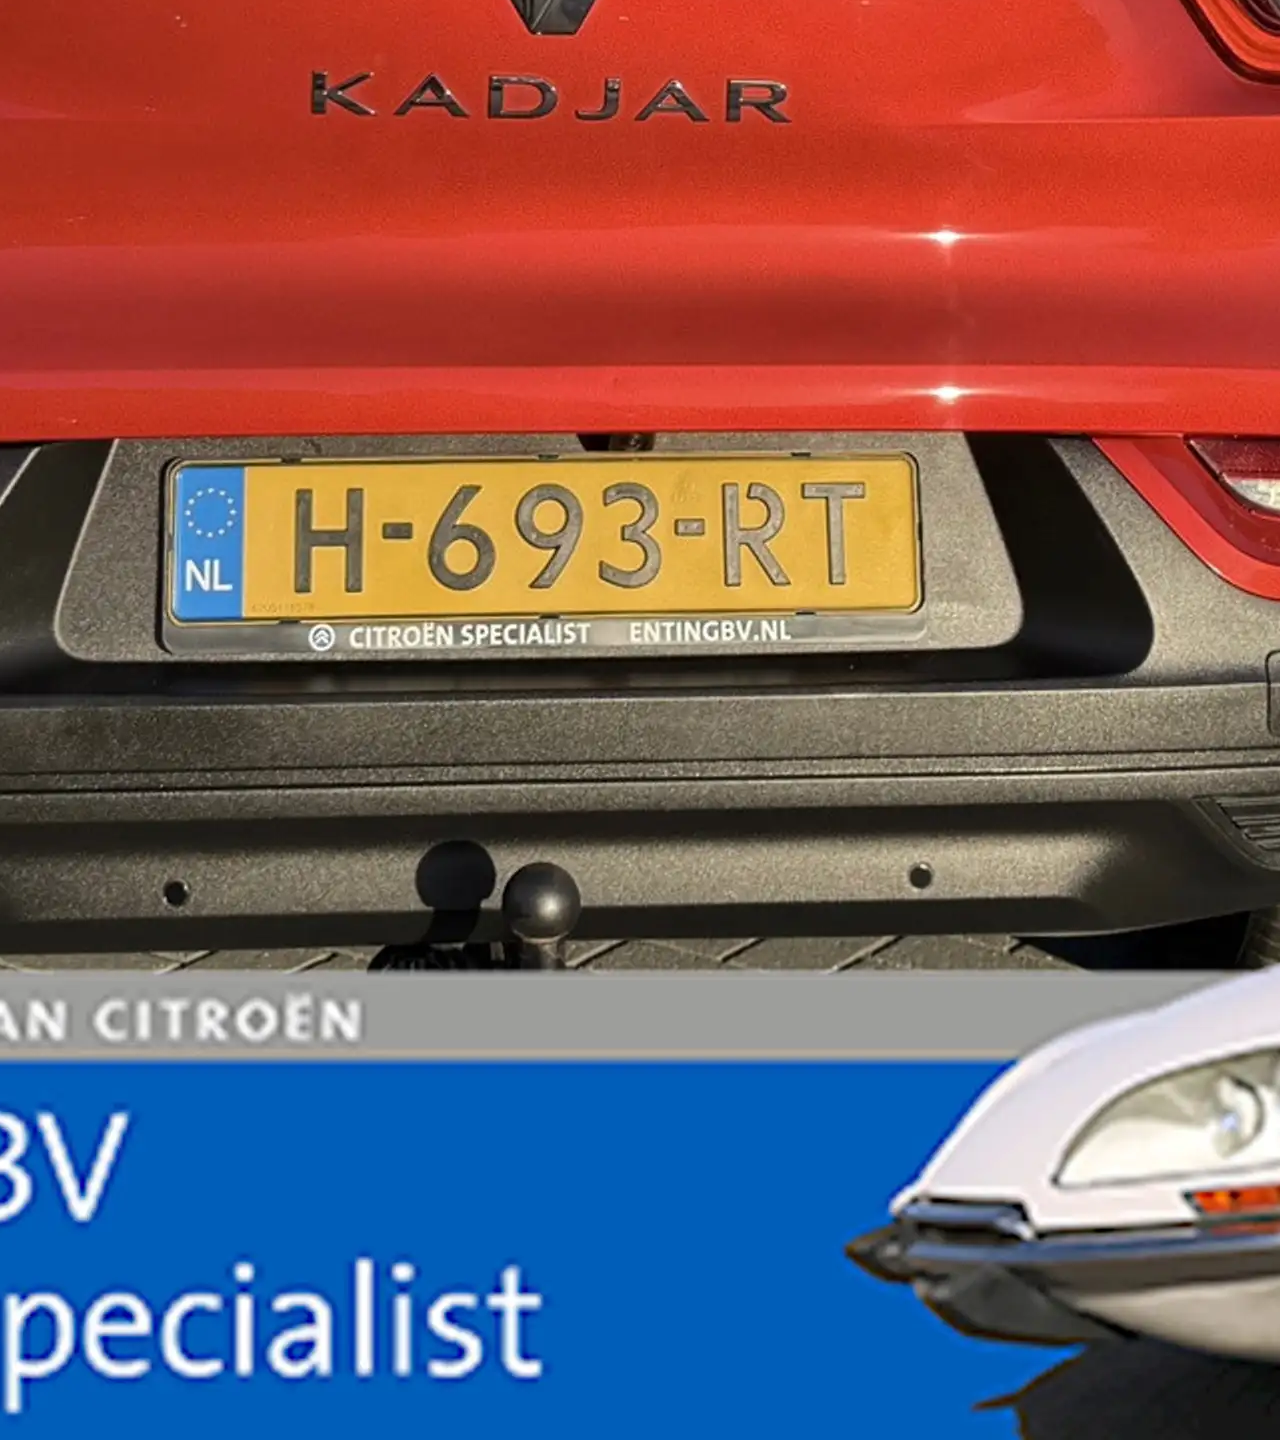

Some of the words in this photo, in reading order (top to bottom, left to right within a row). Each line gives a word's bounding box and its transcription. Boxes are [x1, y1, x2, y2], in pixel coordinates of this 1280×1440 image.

[310, 70, 792, 123] KADJAR
[293, 481, 866, 594] H-693-RT
[185, 559, 233, 592] NL
[349, 621, 453, 650] CITROËN
[461, 621, 591, 647] SPECIALIST
[629, 619, 792, 643] ENTINGBV.NL
